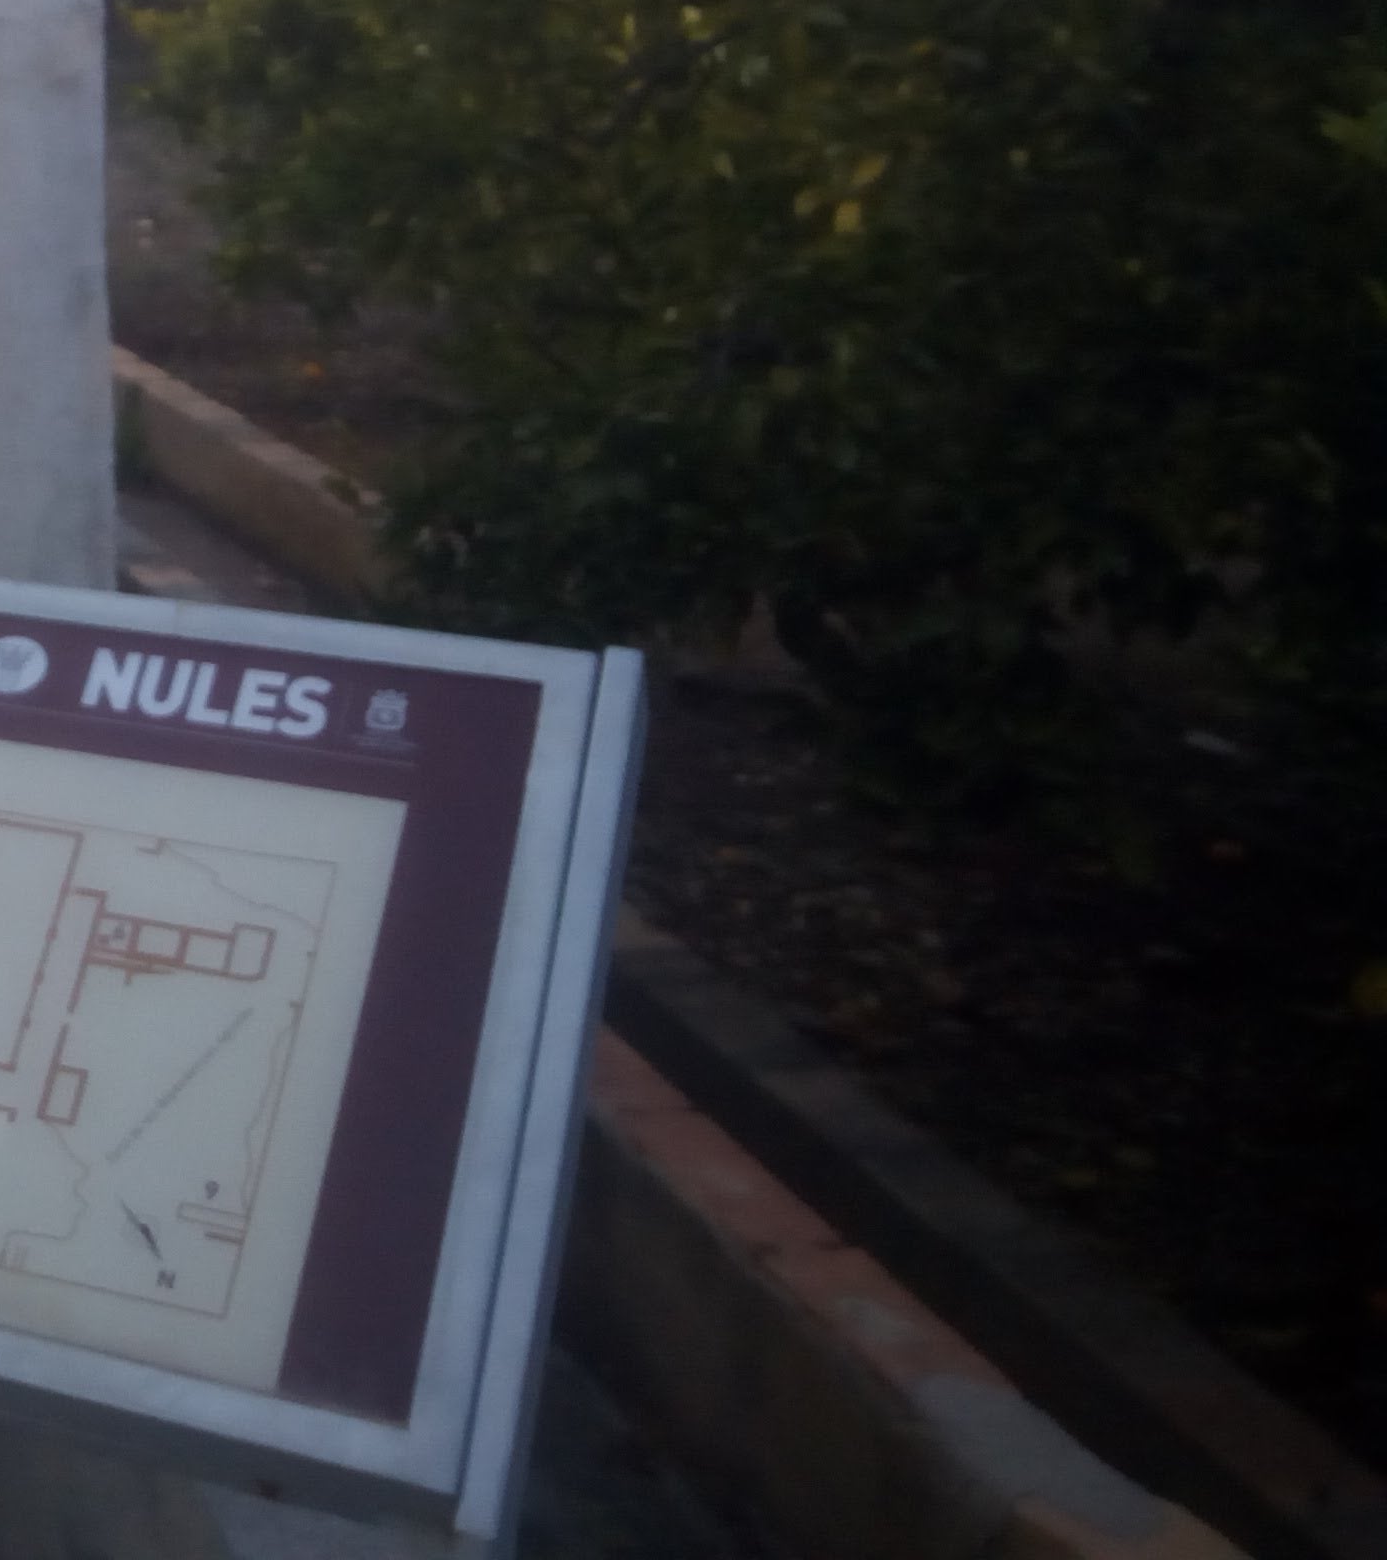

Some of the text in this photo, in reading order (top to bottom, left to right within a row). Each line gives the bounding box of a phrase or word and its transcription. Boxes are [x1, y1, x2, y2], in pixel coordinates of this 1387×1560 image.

[80, 646, 333, 738] NULES
[205, 1180, 220, 1200] 9
[155, 1269, 176, 1290] N
